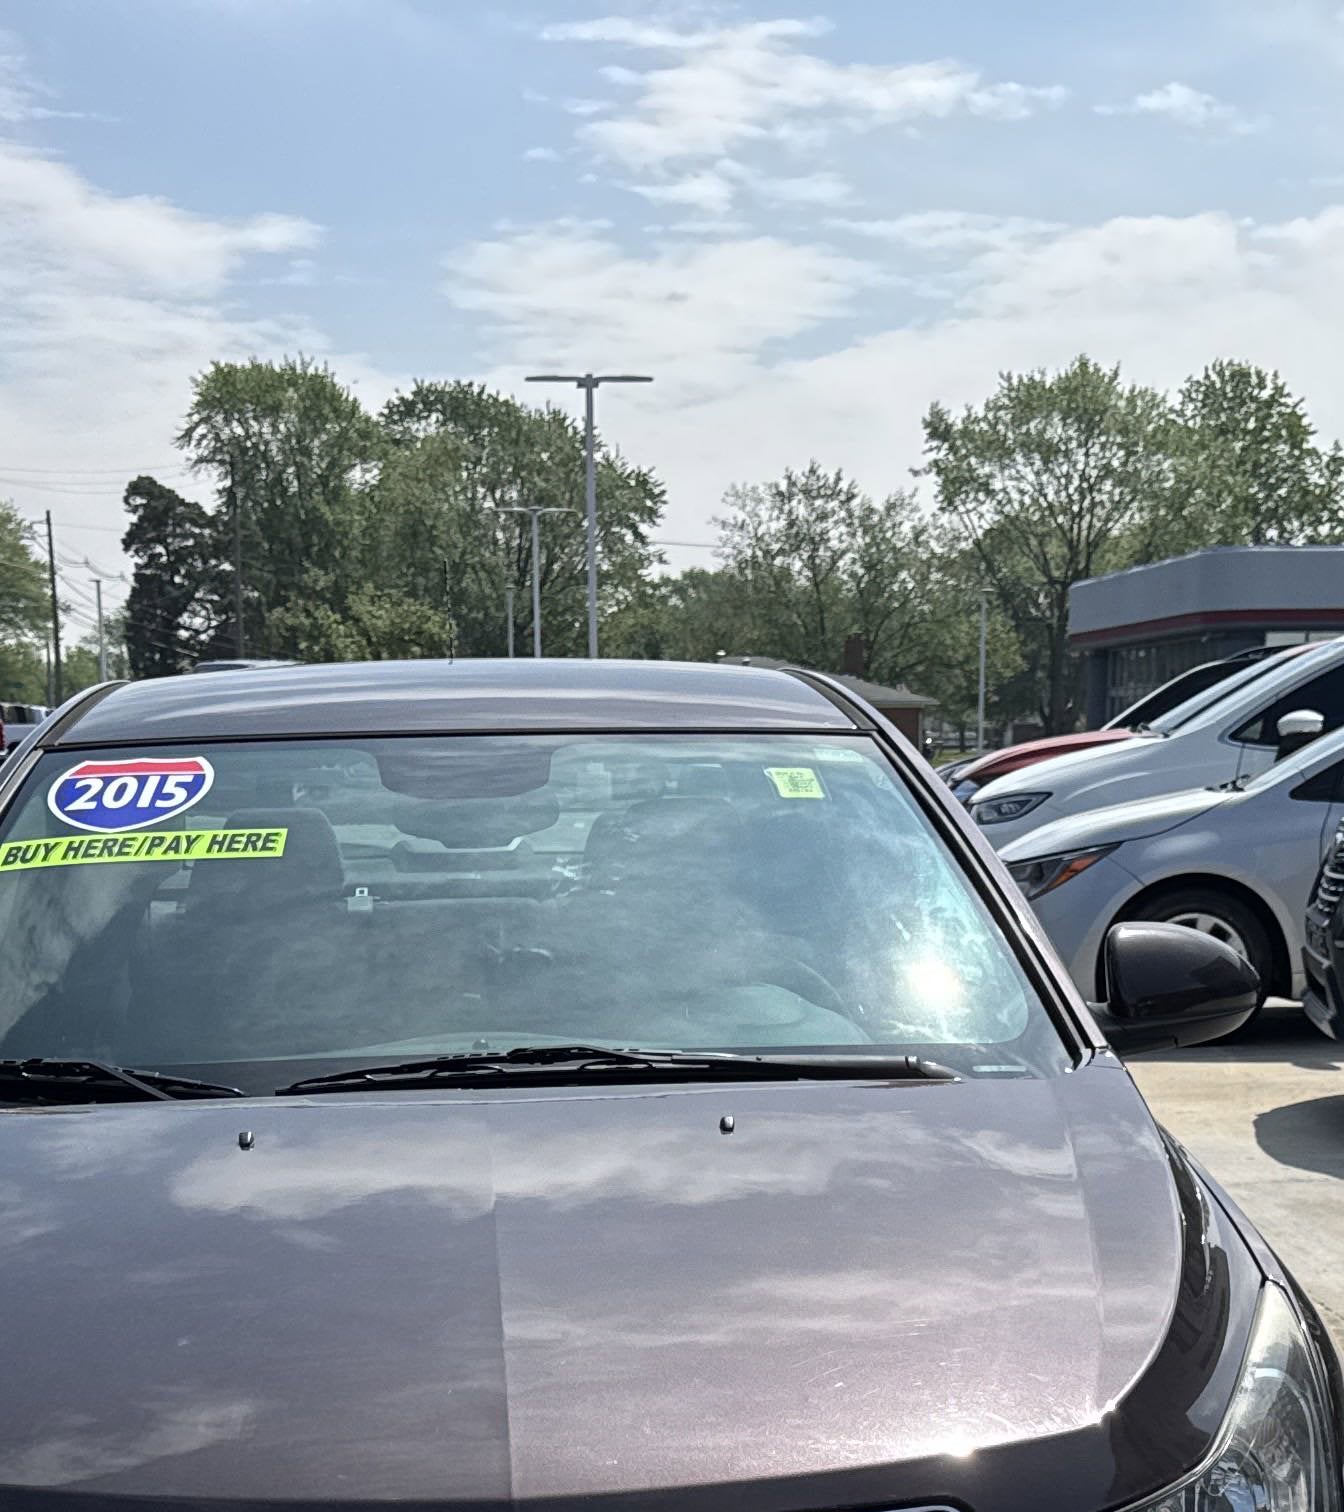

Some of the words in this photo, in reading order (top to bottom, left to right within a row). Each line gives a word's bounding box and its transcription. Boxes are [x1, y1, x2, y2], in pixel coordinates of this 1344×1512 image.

[63, 774, 195, 812] 2015
[0, 841, 63, 867] BUY
[60, 834, 205, 861] HERE/PAY
[205, 831, 283, 854] HERE
